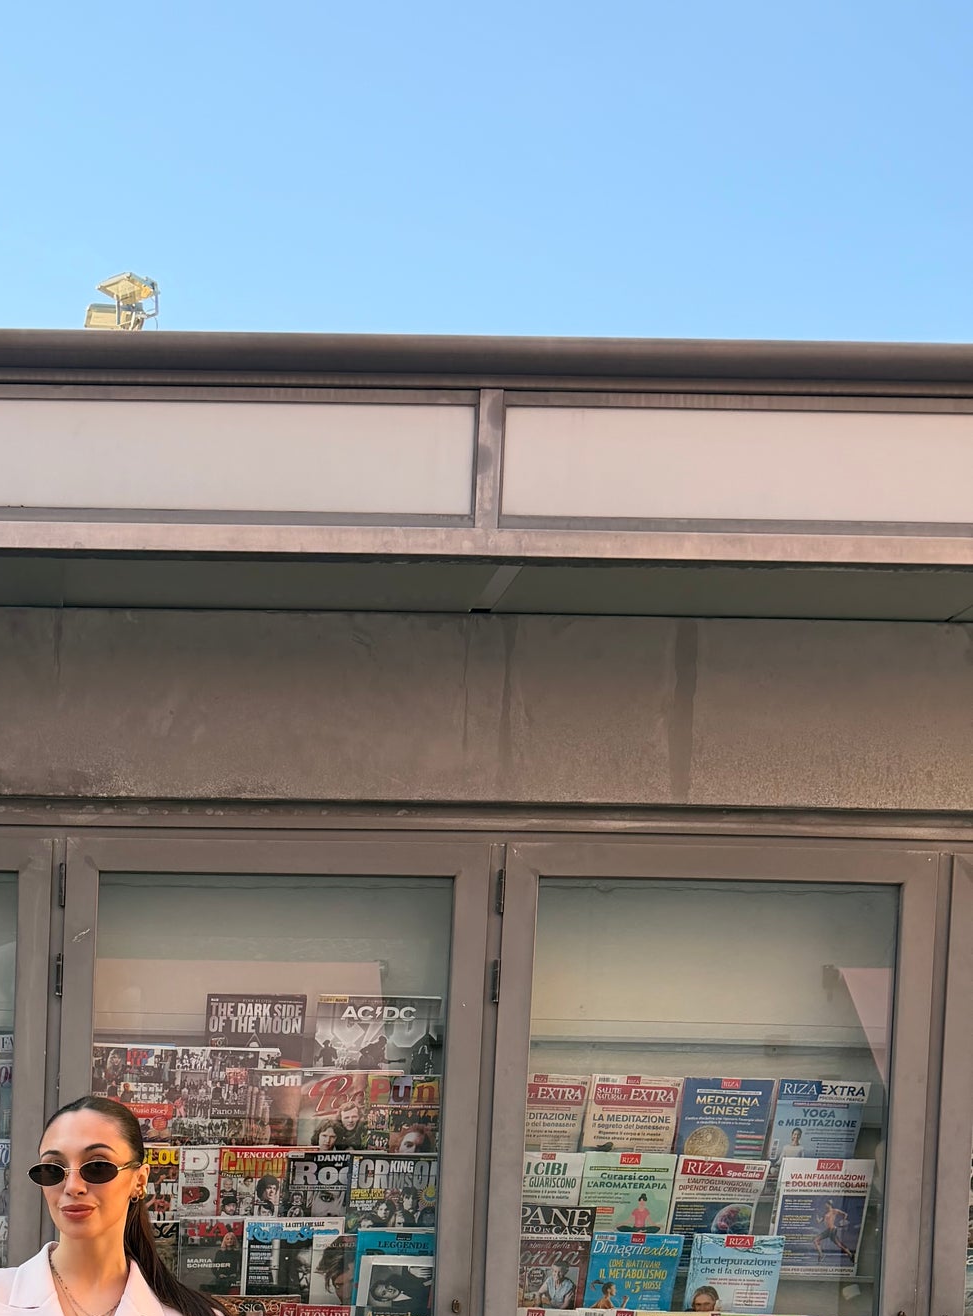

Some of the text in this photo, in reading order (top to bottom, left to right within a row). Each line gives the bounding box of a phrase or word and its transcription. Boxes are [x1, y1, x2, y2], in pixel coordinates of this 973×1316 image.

[211, 1002, 303, 1018] THE DARK SIDE
[209, 1016, 302, 1034] OF THE MOON
[537, 1087, 582, 1100] EXTRA
[783, 1083, 866, 1097] RIZA EXTRA
[630, 1089, 674, 1103] EXTRA
[695, 1095, 760, 1107] MEDICINA
[702, 1106, 749, 1117] CINESE
[802, 1108, 836, 1119] YOGA
[592, 1113, 671, 1124] LA MEDITAZIONE
[785, 1118, 857, 1128] MEDITAZIONE
[389, 1160, 414, 1173] KING
[533, 1162, 568, 1176] CIBI
[686, 1161, 761, 1179] RIZA Speciale
[819, 1162, 840, 1170] RIZA
[600, 1172, 641, 1181] Curarsi
[529, 1177, 577, 1188] GUARISCONO
[587, 1181, 667, 1190] L'AROMATERAPIA
[822, 1181, 868, 1189] ARTICOLARI
[728, 1237, 751, 1246] RIZA
[714, 1256, 777, 1269] depurazione
[608, 1268, 668, 1280] METABOLISMO
[700, 1267, 773, 1277] che dimagrire
